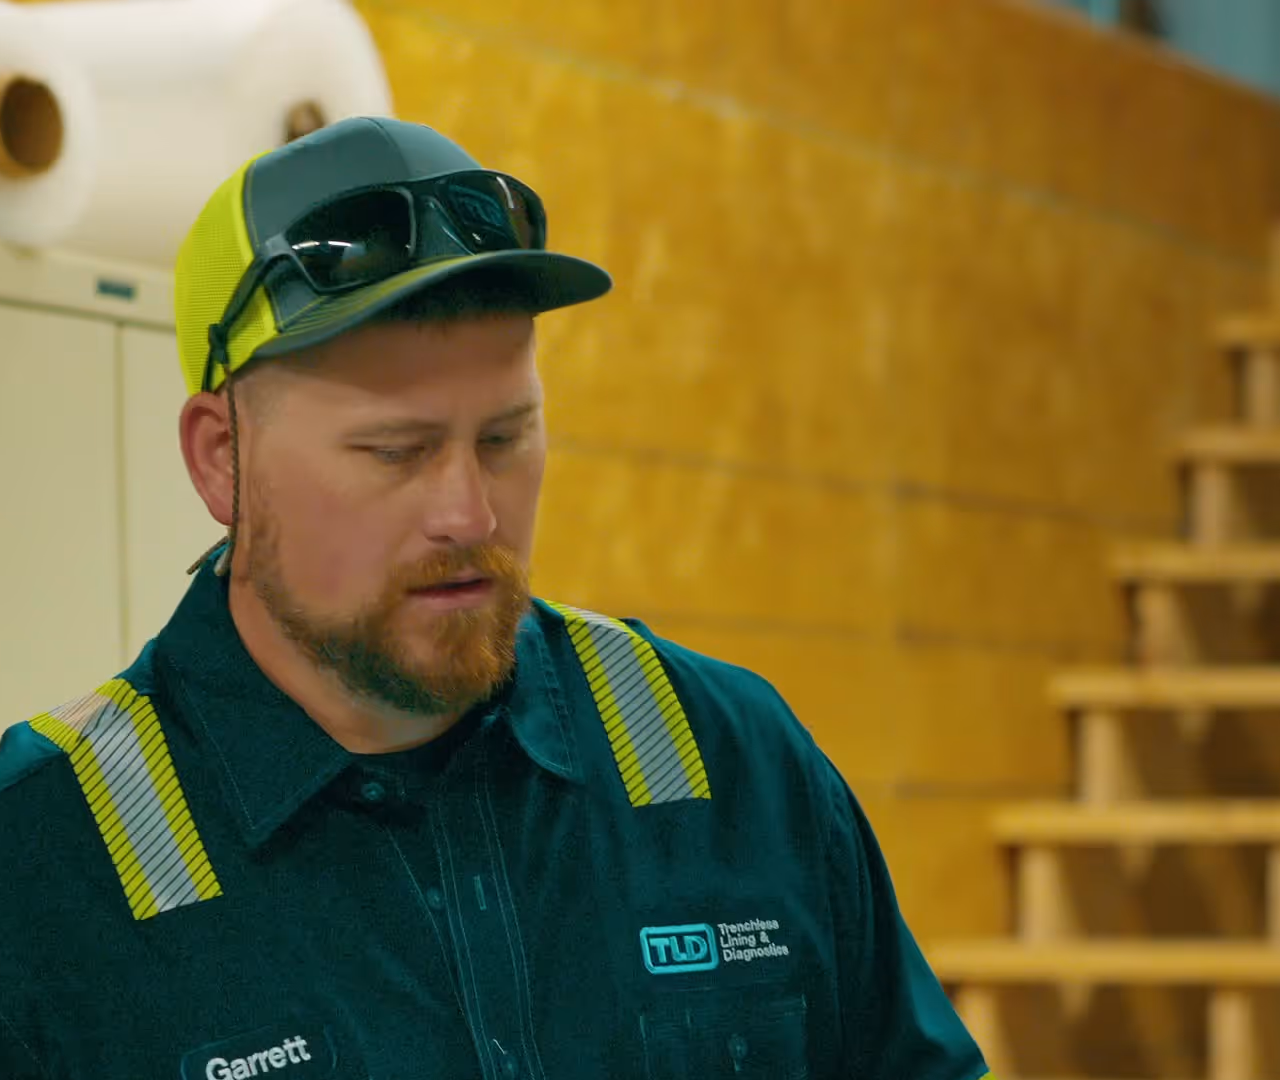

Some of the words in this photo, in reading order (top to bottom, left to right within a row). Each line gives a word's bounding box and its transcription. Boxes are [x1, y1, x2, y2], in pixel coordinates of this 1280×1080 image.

[718, 918, 780, 935] Trenchless
[720, 934, 757, 948] Lining
[760, 931, 770, 944] &
[649, 935, 708, 963] TLD
[723, 943, 790, 962] Diagnostics
